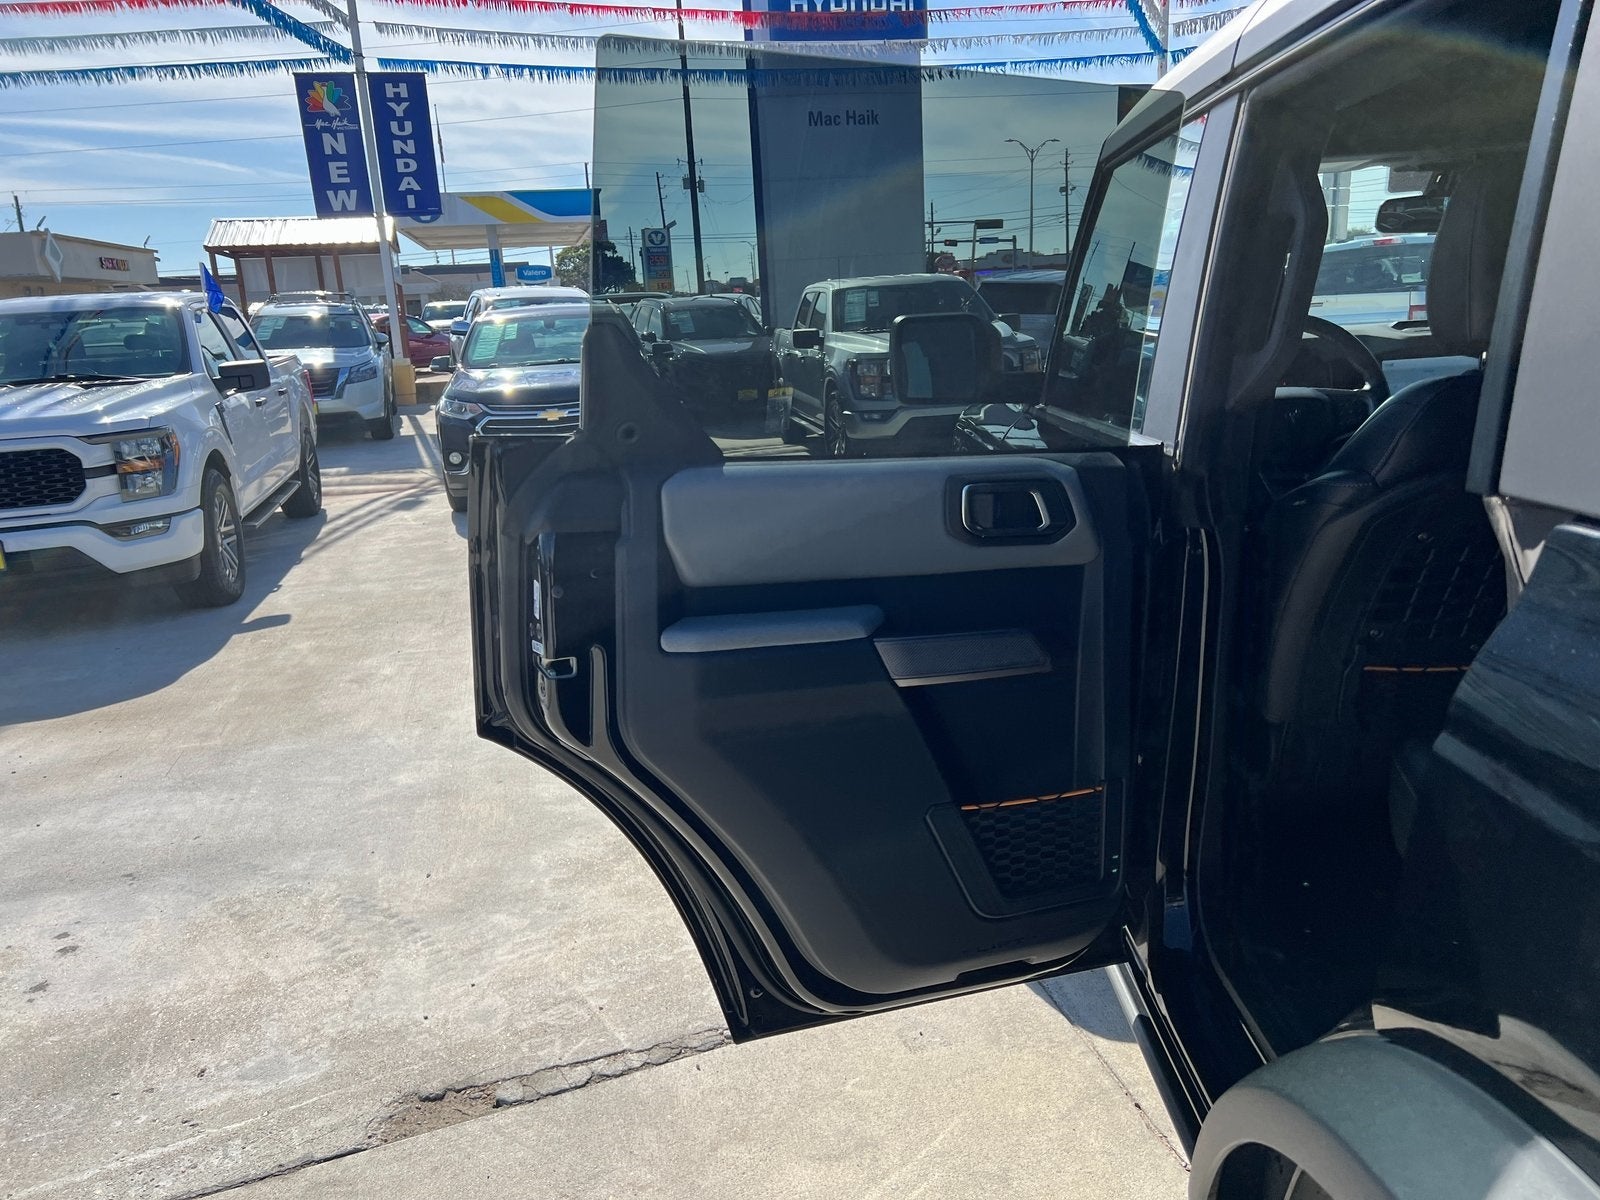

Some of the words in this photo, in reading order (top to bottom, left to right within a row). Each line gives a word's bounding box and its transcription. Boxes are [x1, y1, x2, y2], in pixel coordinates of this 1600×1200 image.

[808, 110, 842, 127] Mac
[845, 109, 879, 126] Haik
[384, 82, 422, 209] HYUNDAI
[321, 132, 358, 212] NEW
[522, 269, 547, 277] Valero
